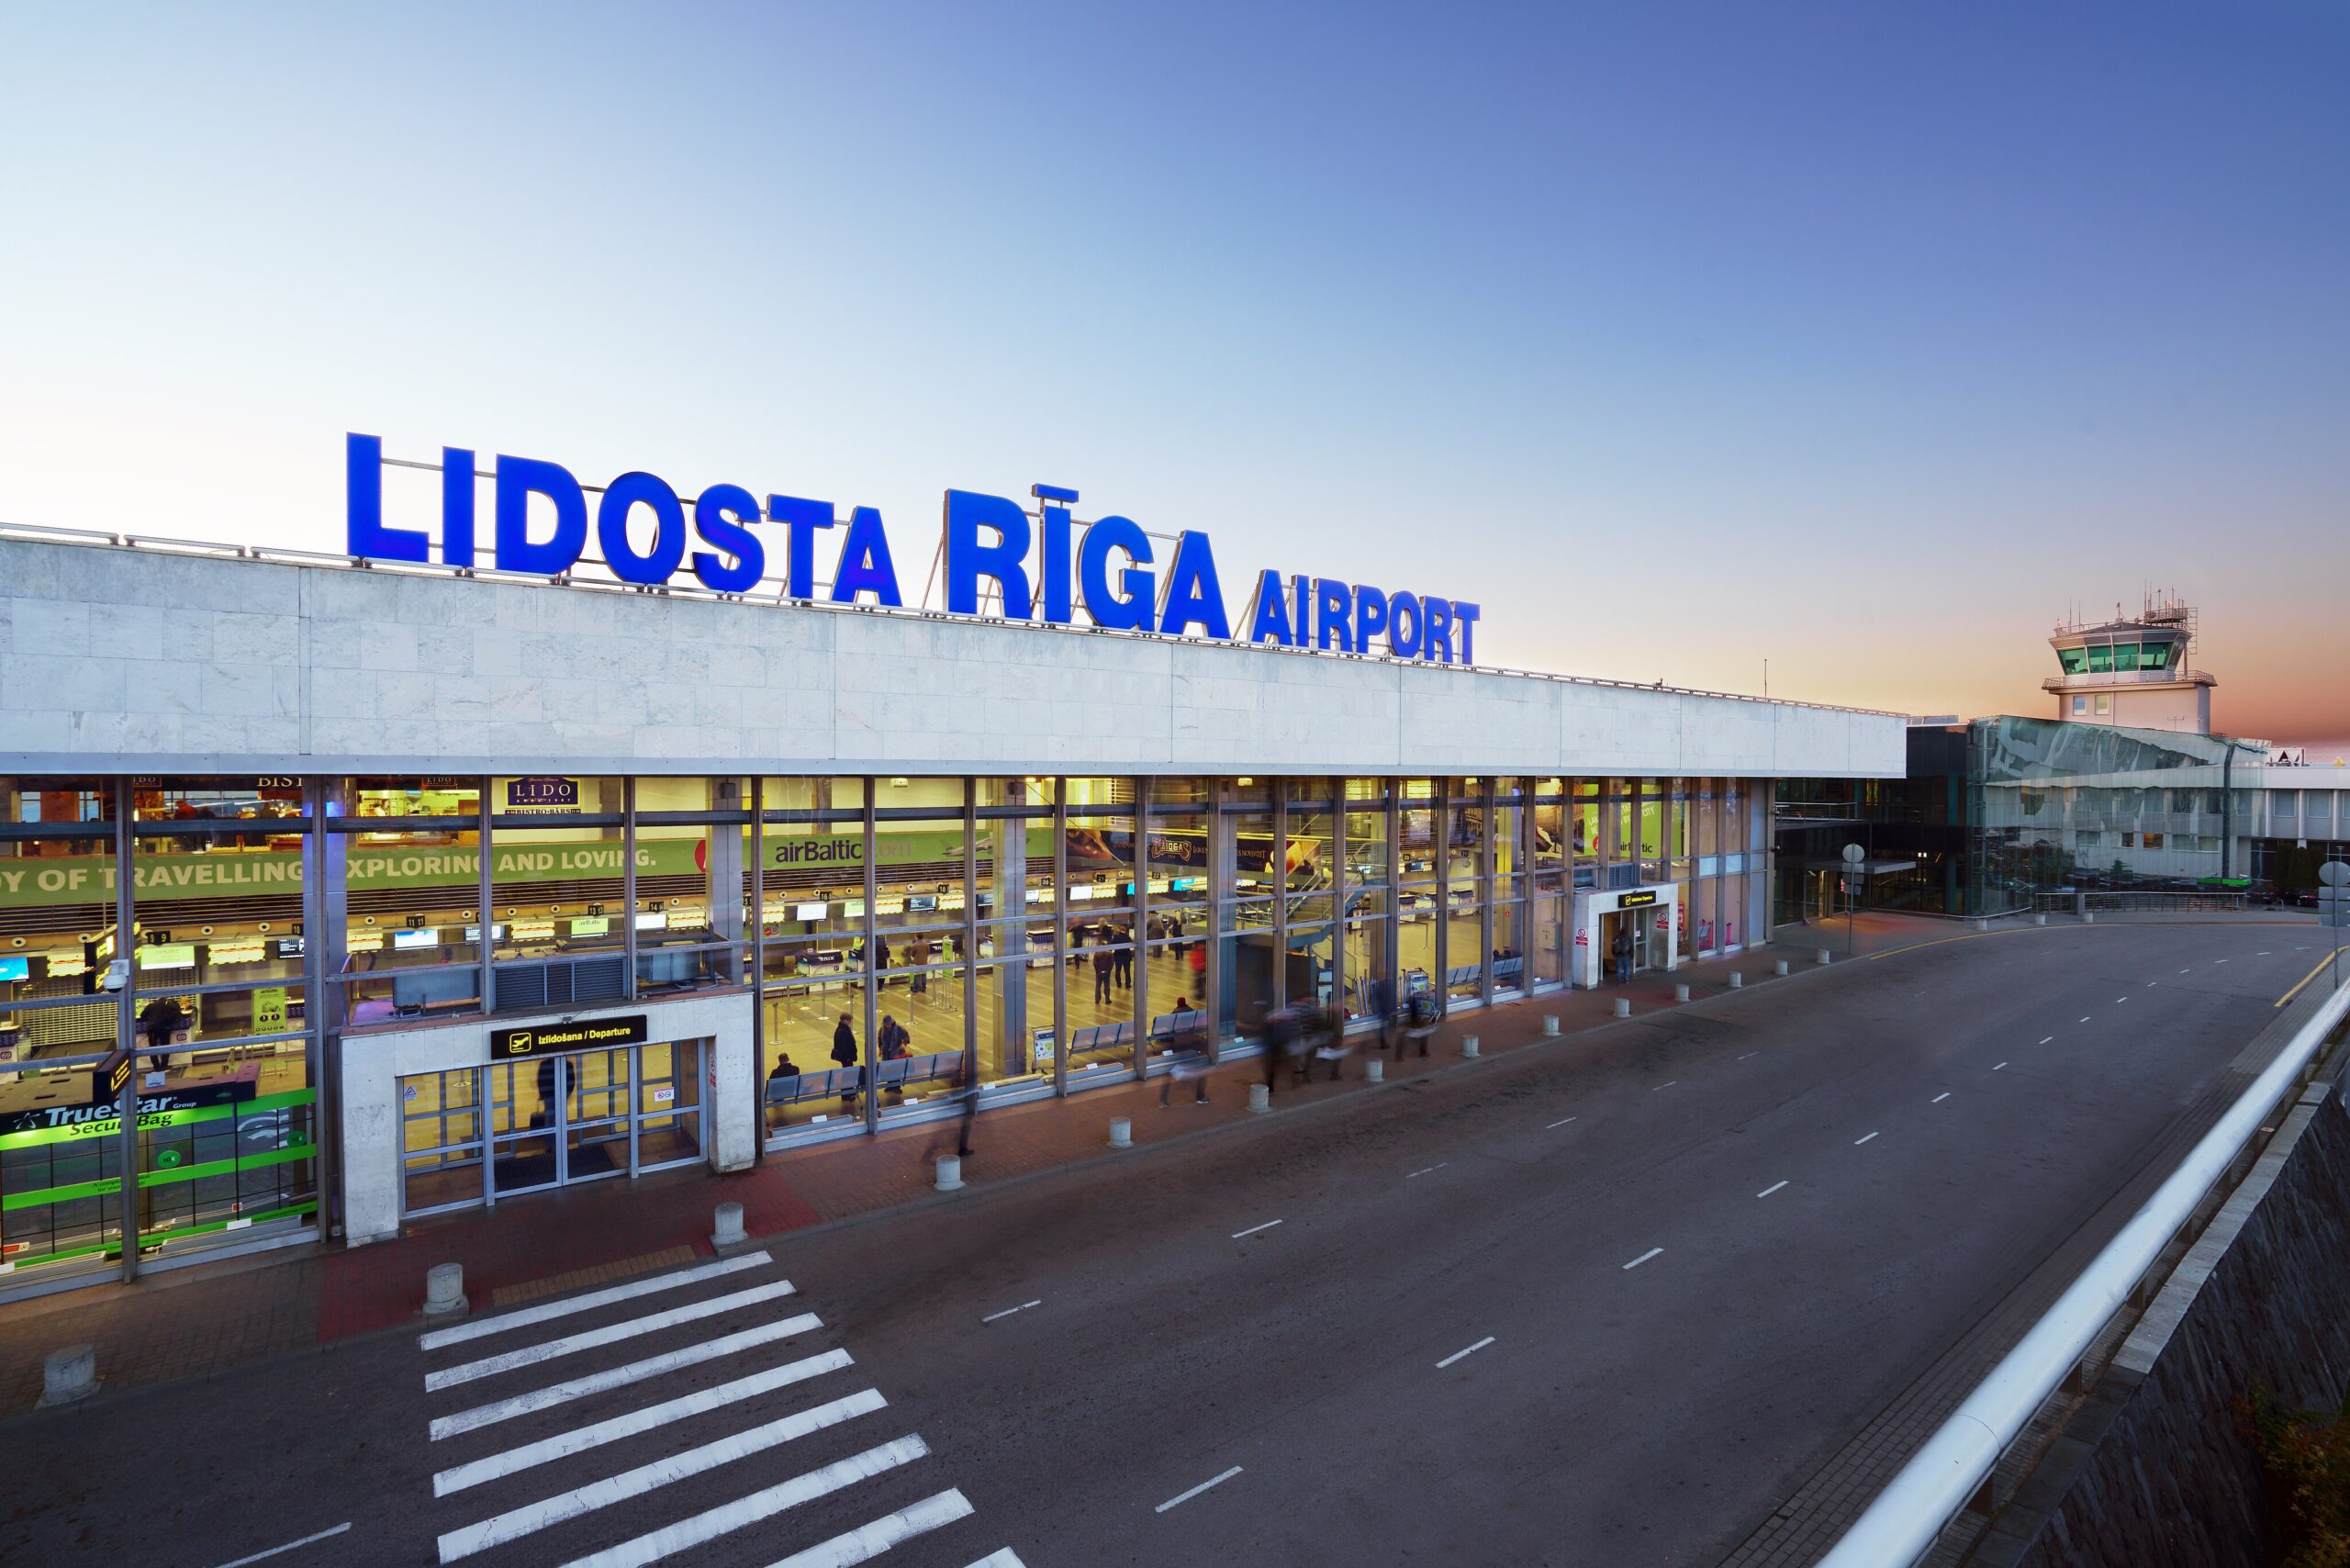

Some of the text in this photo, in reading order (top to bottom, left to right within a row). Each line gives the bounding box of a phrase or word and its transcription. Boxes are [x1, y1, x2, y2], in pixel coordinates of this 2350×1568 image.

[346, 431, 1481, 665] LIDOSTA RĪGA AIRPORT
[516, 784, 571, 797] LIDO
[0, 870, 27, 892] Y
[38, 868, 88, 891] OF
[98, 861, 303, 890] TRAVELLING
[346, 855, 480, 879] XPLORIN
[498, 853, 554, 872] AND
[538, 1032, 583, 1045] Izlidošana
[589, 1027, 631, 1039] Departure
[173, 1101, 196, 1109] Group
[138, 1114, 173, 1127] Bag
